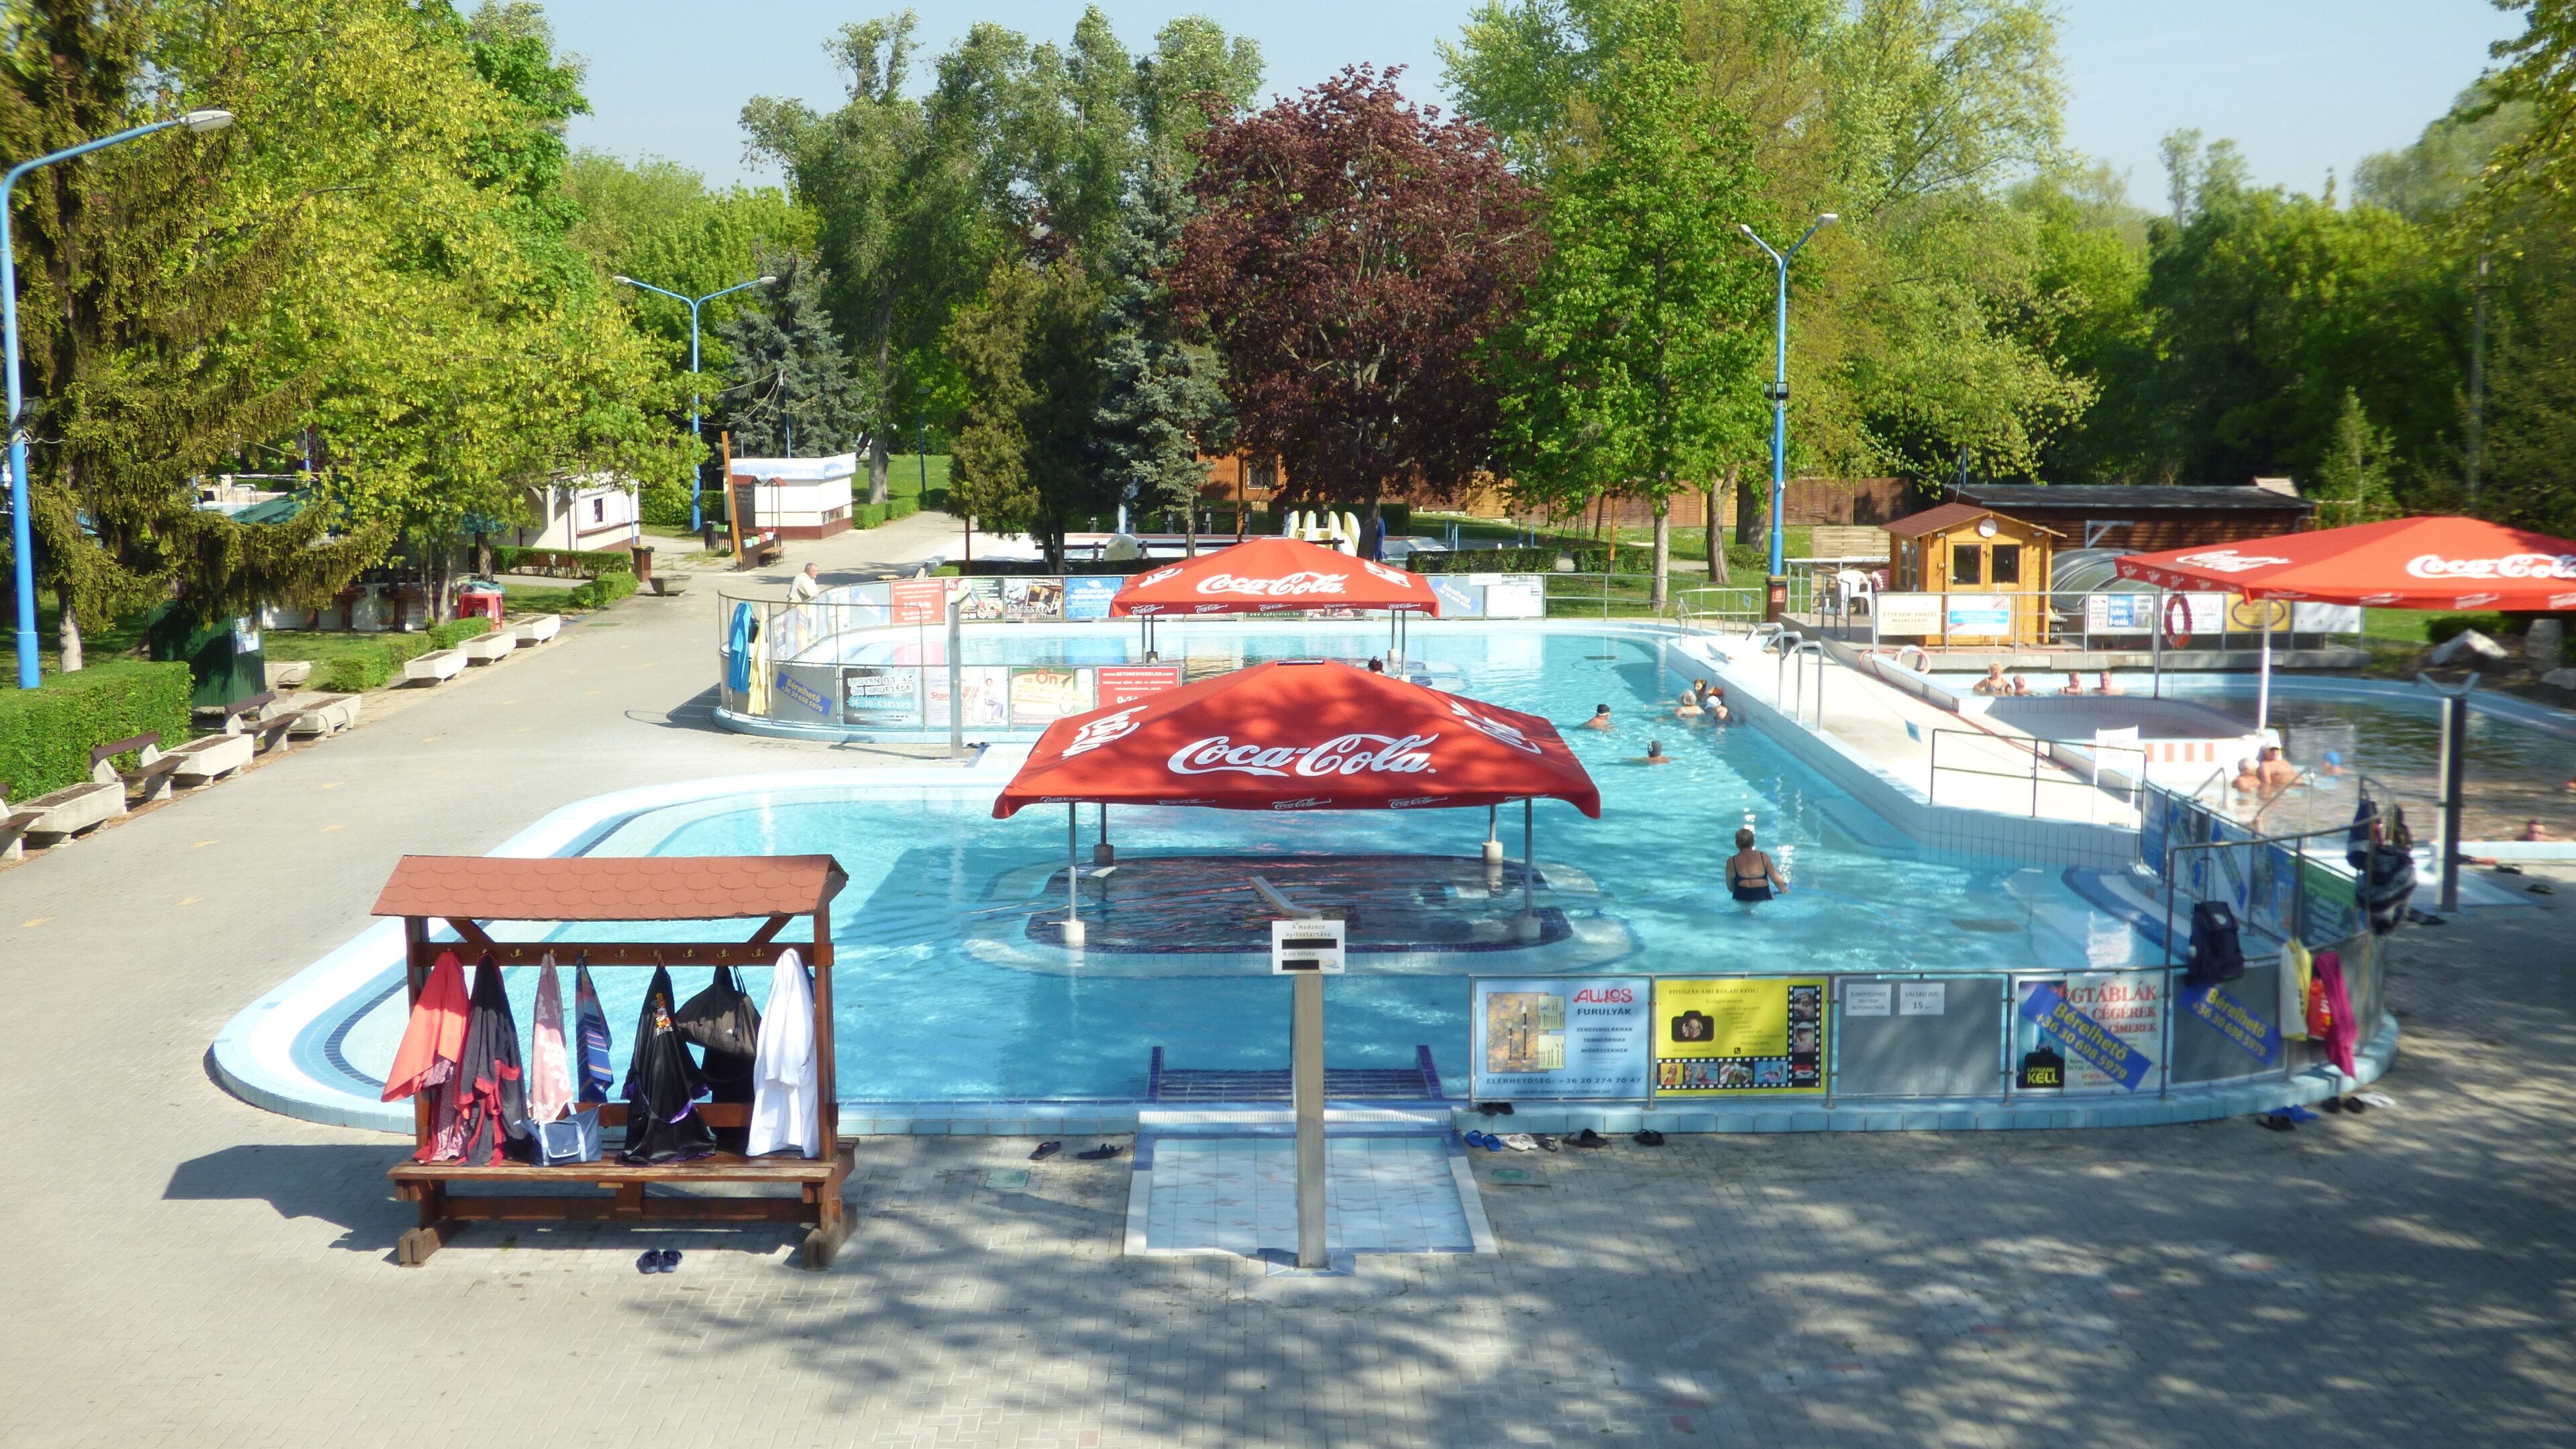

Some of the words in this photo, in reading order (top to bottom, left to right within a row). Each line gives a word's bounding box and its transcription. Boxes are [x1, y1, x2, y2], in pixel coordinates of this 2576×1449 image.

[1196, 571, 1349, 596] Coca-Cola
[849, 678, 881, 686] LEGYEN
[1036, 669, 1058, 685] Ön
[1167, 733, 1440, 777] Coca-Cola
[1577, 1006, 1631, 1016] FURULYÁK
[1913, 1002, 1923, 1010] 15
[2059, 1028, 2076, 1044] 30
[2027, 1072, 2060, 1085] KELL
